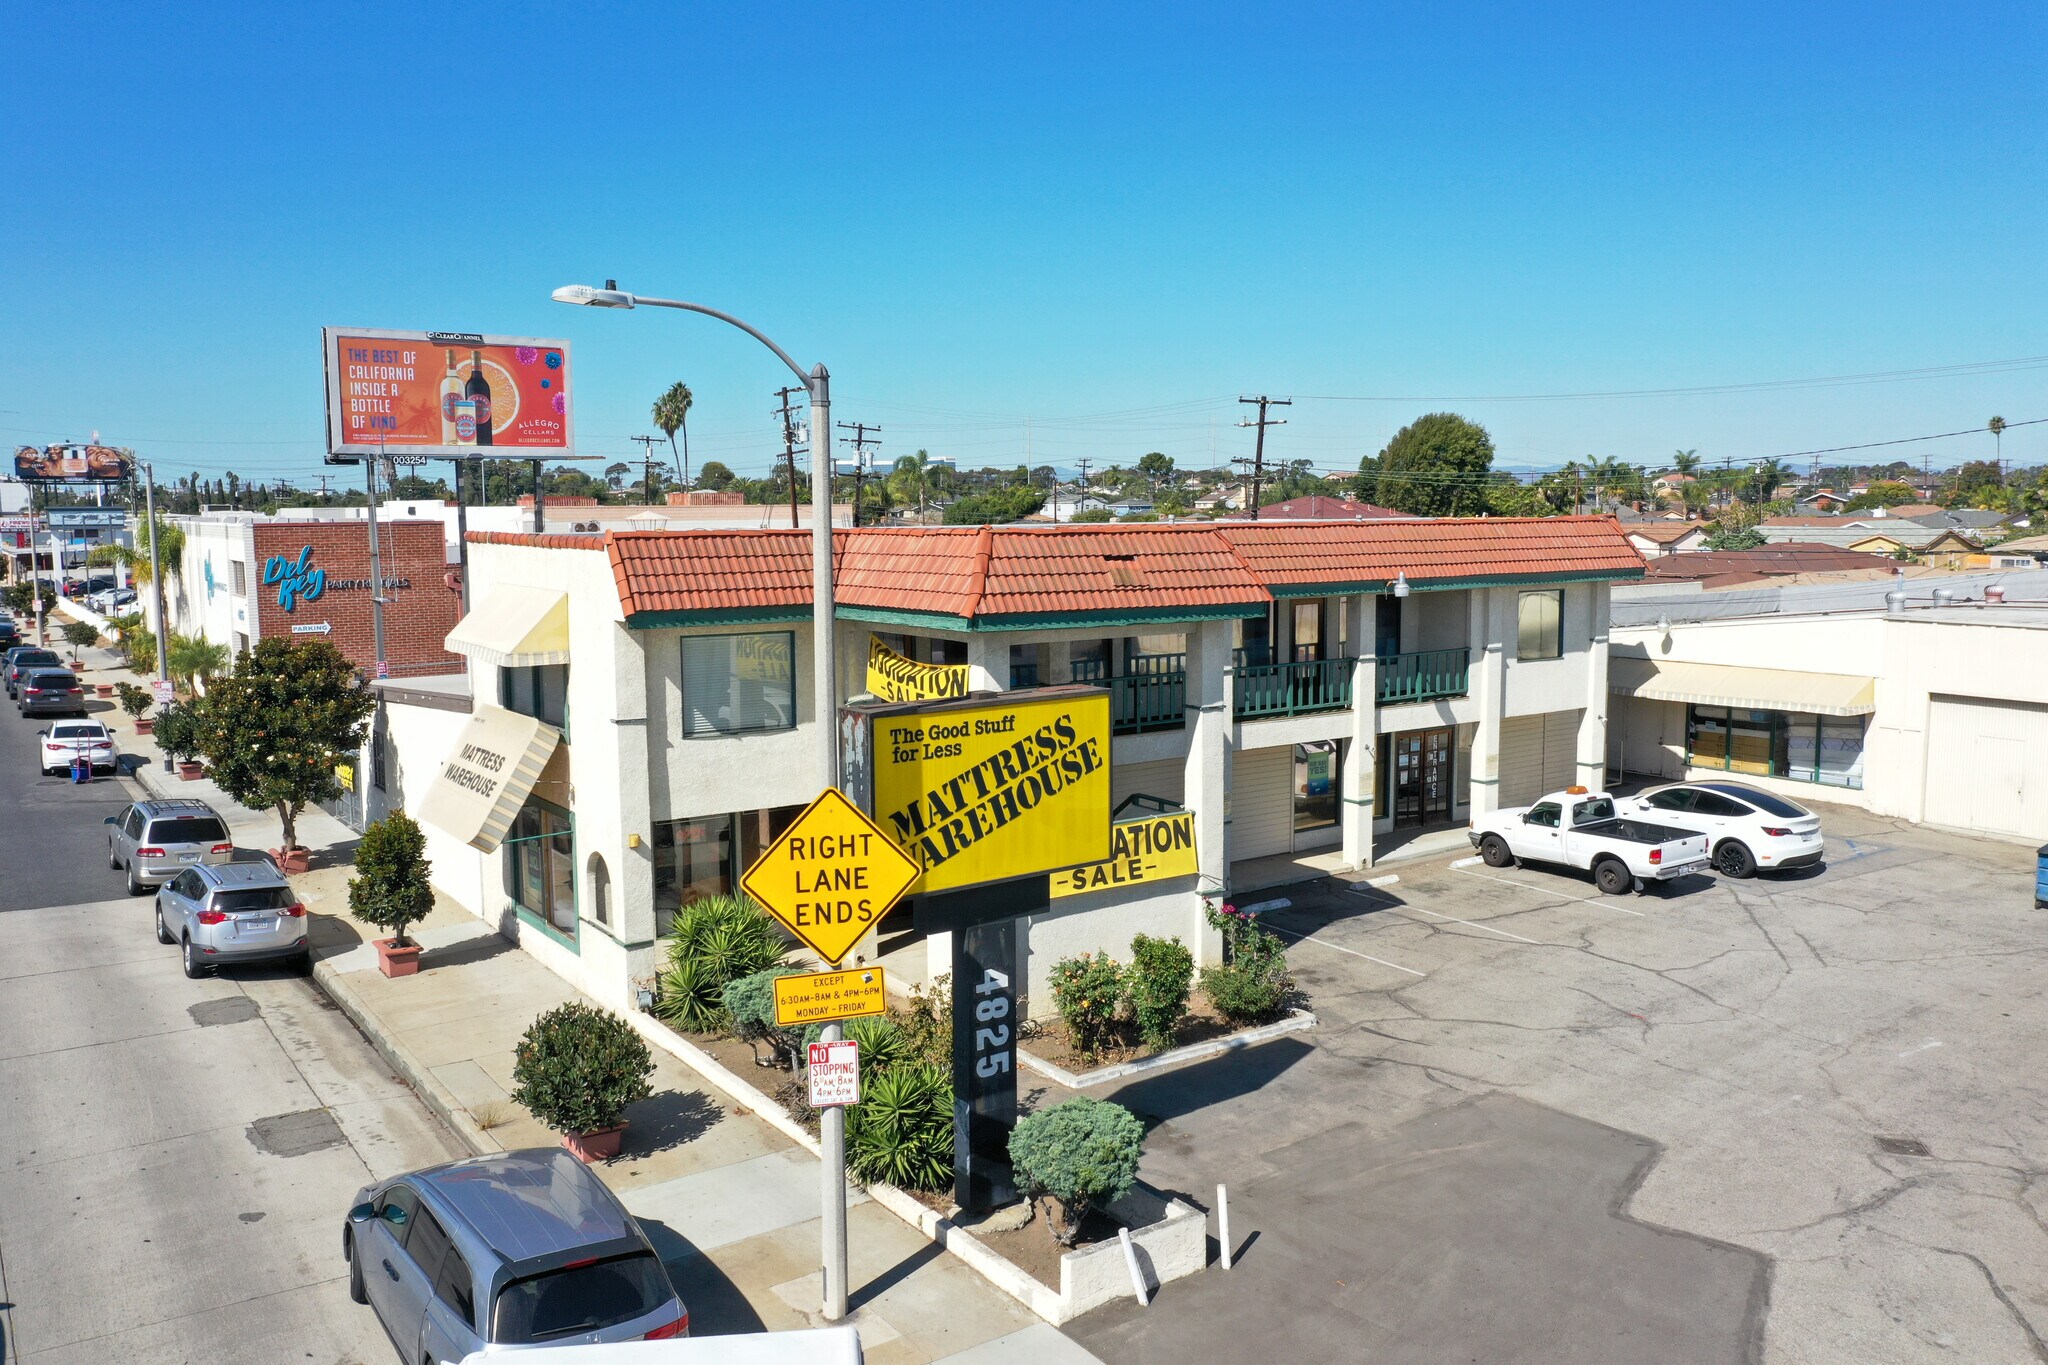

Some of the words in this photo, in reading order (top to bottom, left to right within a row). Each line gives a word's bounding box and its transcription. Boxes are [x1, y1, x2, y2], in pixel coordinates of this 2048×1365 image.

[348, 348, 368, 362] THE
[372, 349, 399, 363] BEST
[403, 351, 417, 364] OF
[349, 365, 415, 380] CALIFORNIA
[350, 382, 387, 396] INSIDE
[391, 383, 398, 397] A
[351, 398, 391, 413] BOTTLE
[352, 415, 366, 429] OF
[370, 415, 397, 430] VINO
[518, 419, 560, 430] ALLEGRO
[393, 456, 427, 465] 003254
[263, 545, 313, 584] Del
[278, 569, 325, 611] Rey
[326, 579, 360, 589] PARTY
[889, 727, 925, 745] The
[928, 721, 970, 741] Good
[974, 715, 1016, 736] Stuff
[459, 743, 506, 772] MATTRESS
[892, 746, 919, 764] for
[922, 743, 963, 760] Less
[1309, 766, 1328, 775] YES!
[444, 763, 498, 798] WAREHOUSE
[888, 714, 1076, 846] MATTRESS
[909, 737, 1104, 874] AREHOUSE
[789, 833, 873, 861] RIGHT
[795, 866, 869, 894] LANE
[795, 898, 873, 926] ENDS
[813, 976, 845, 987] EXCEPT
[834, 991, 841, 1000] &
[796, 1006, 829, 1018] MONDAY
[838, 1002, 867, 1013] FRIDAY
[976, 968, 1010, 1078] 4825
[811, 1048, 827, 1063] NO
[812, 1062, 855, 1077] STOPPING
